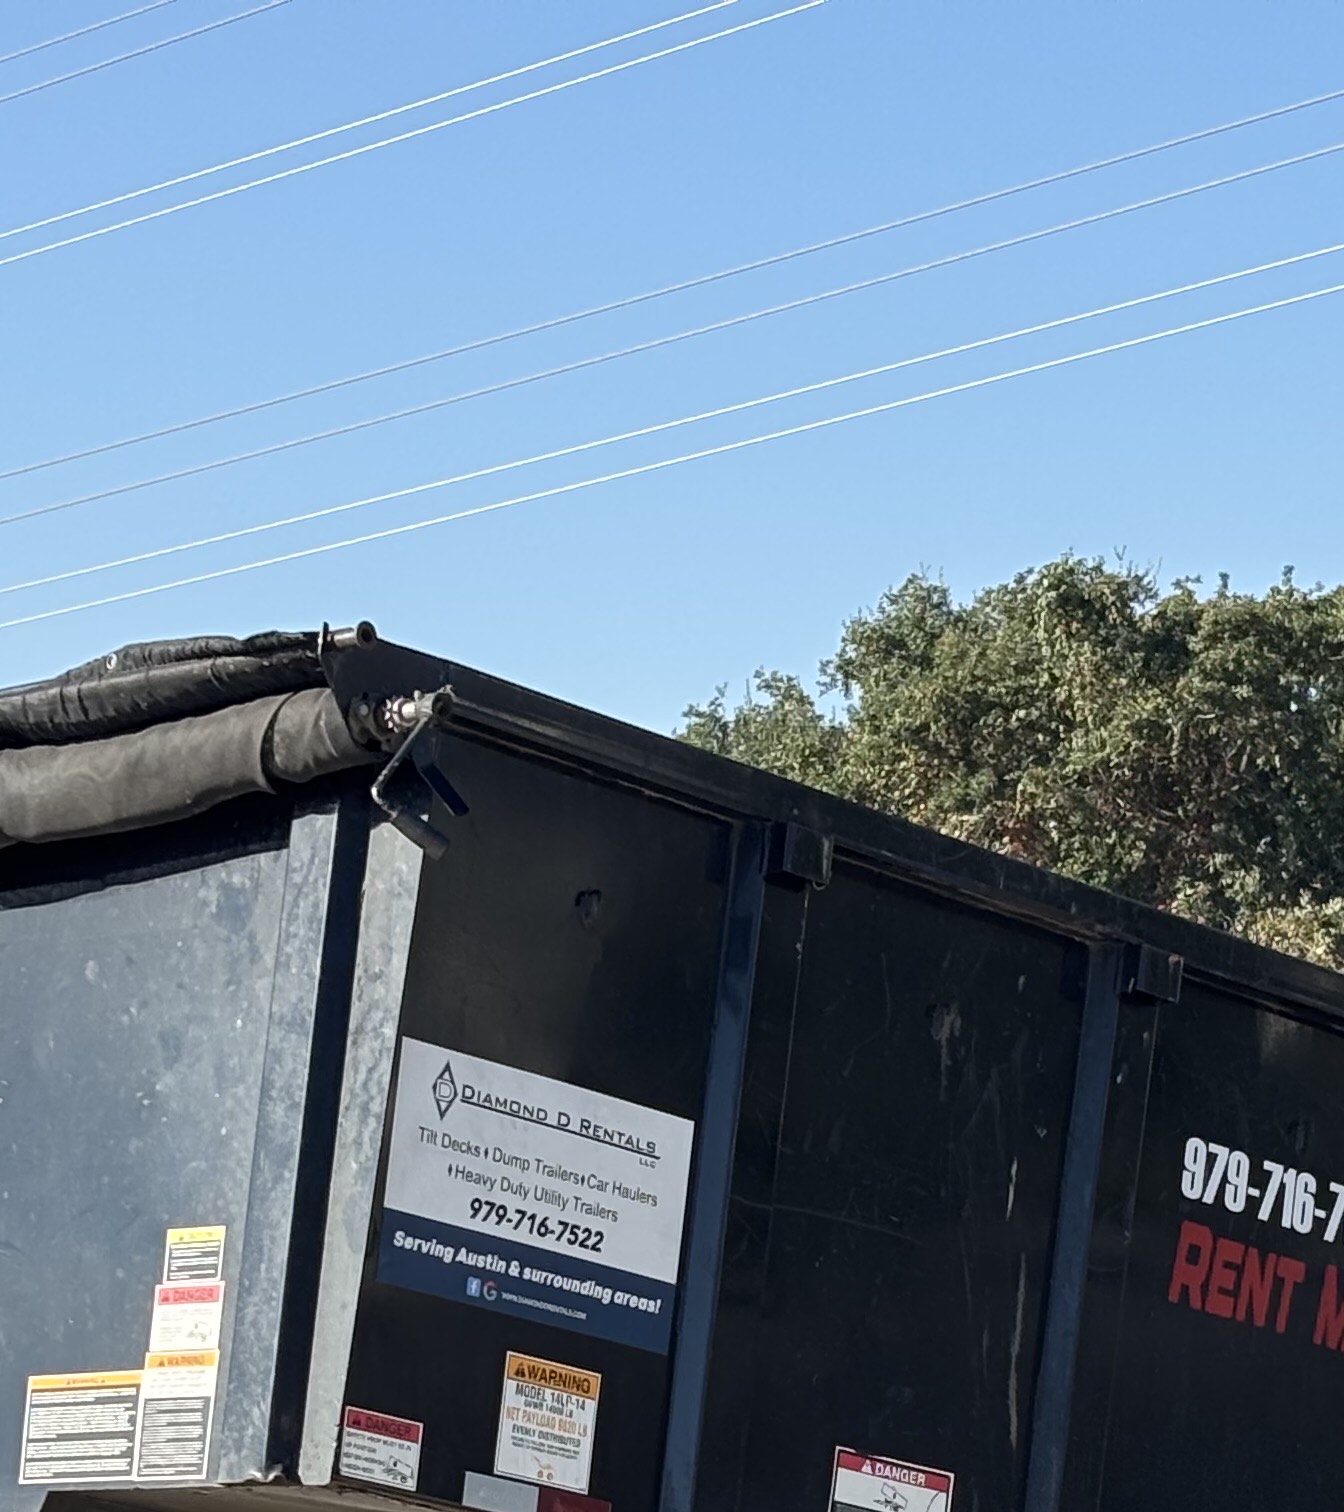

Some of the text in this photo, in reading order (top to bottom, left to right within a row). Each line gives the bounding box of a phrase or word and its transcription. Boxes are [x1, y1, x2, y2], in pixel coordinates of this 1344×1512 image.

[461, 1084, 657, 1154] DIAMOND D RENTALS
[418, 1125, 658, 1207] Tilt Decks Dump Trailers Car Haulers
[638, 1157, 657, 1169] LLC
[454, 1163, 619, 1223] Heavy Duty Utility Trailers
[469, 1197, 605, 1253] 979-716-7522
[393, 1230, 455, 1264] Serving
[455, 1246, 507, 1274] Austin
[508, 1260, 522, 1278] &
[522, 1266, 613, 1305] surrounding
[613, 1290, 663, 1315] areas!
[1168, 1219, 1306, 1334] RENT
[515, 1383, 547, 1402] MODEL
[527, 1364, 591, 1394] WARNING
[365, 1415, 412, 1439] DANGER
[505, 1406, 521, 1421] NET
[521, 1409, 556, 1430] PAYLOAD
[537, 1430, 581, 1448] DISTRIBUTED
[875, 1462, 926, 1487] DANGER
